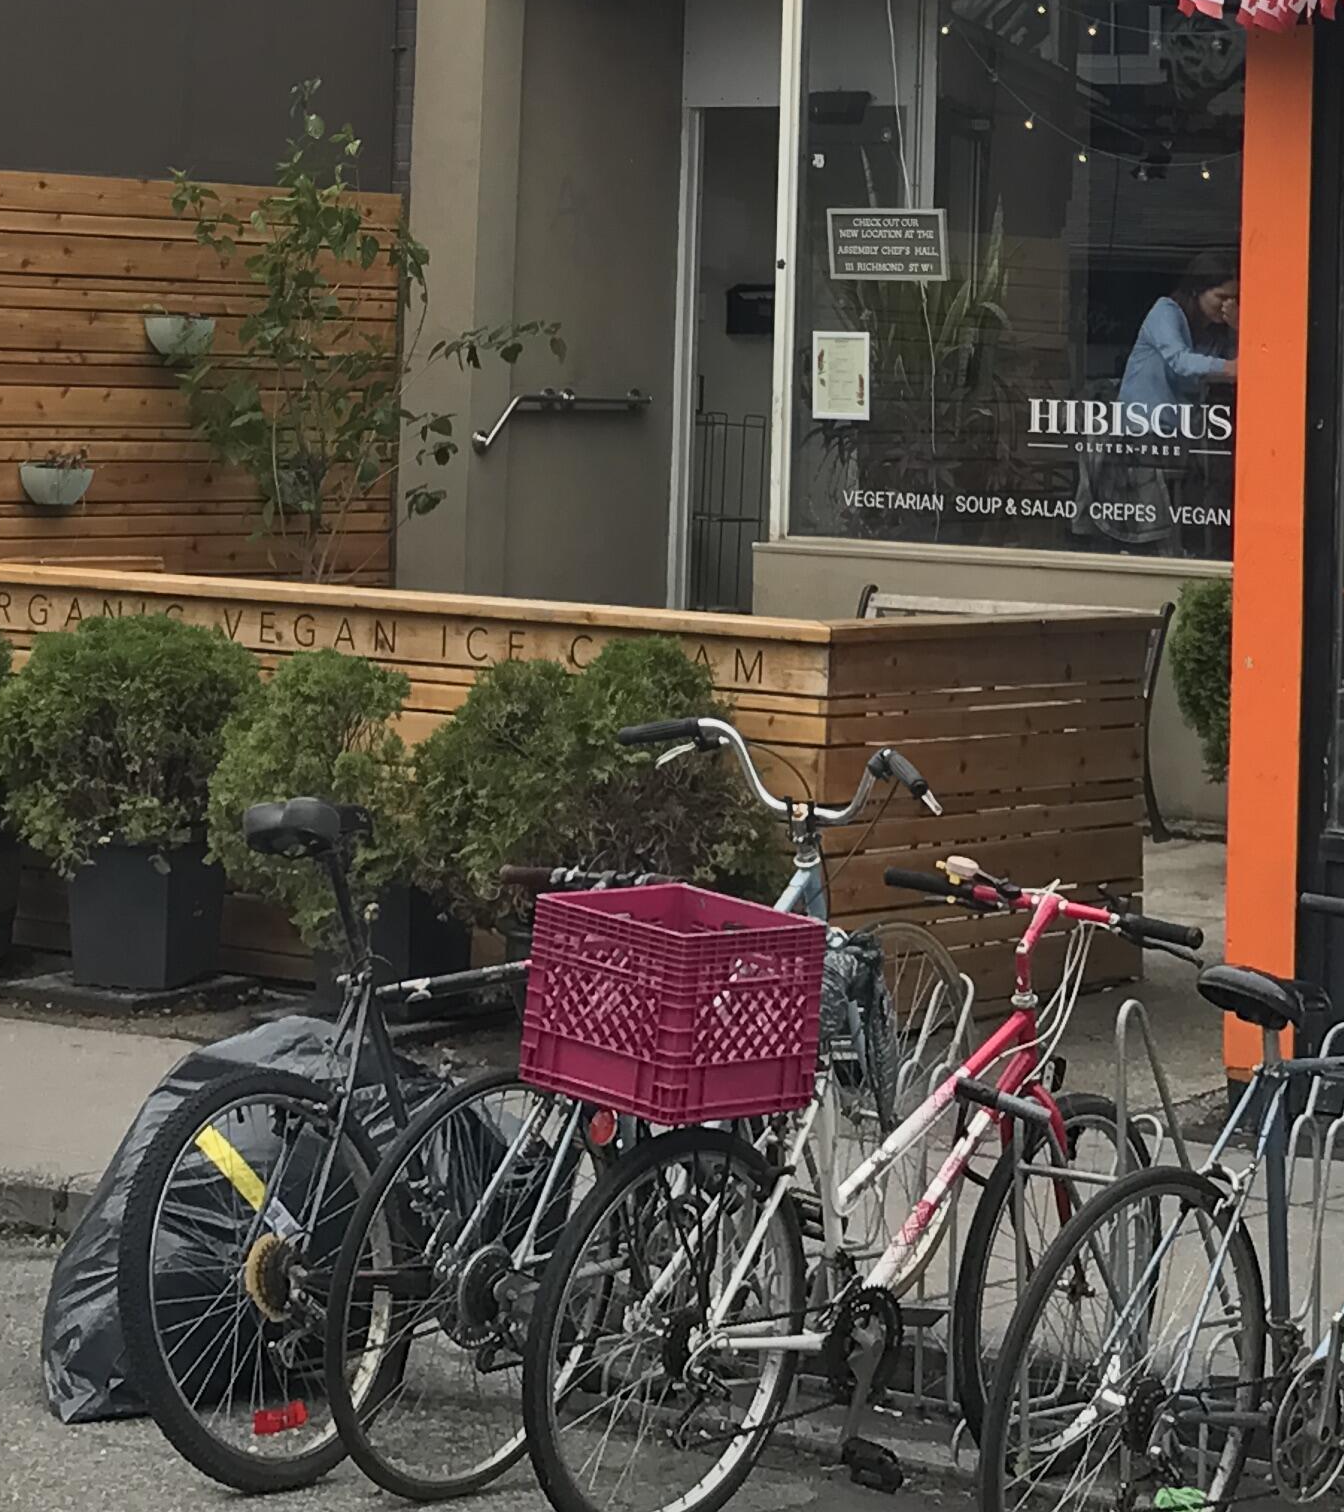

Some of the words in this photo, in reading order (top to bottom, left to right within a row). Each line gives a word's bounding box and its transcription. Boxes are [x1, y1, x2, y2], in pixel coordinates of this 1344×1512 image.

[852, 218, 882, 227] CHECK
[882, 218, 900, 227] OUT
[900, 218, 920, 227] OUR
[839, 230, 858, 238] NEW
[861, 230, 903, 239] LOCATION
[904, 230, 915, 239] AT
[917, 230, 935, 239] THE
[837, 246, 880, 255] ASSEMBLY
[881, 246, 911, 255] CHEF'S
[857, 262, 905, 272] RICHMOND
[908, 263, 920, 272] ST
[1027, 399, 1233, 440] HIBISCUS
[1074, 441, 1182, 457] GLUTEN-FREE
[843, 490, 945, 512] VEGETARIAN
[955, 495, 1003, 515] SOUP
[1004, 497, 1018, 516] &
[1020, 498, 1078, 519] SALAD
[1089, 503, 1157, 523] CREPES
[1169, 506, 1232, 527] VEGAN
[223, 606, 397, 654] VEGAN
[441, 624, 526, 662] ICE
[570, 634, 764, 685] CAM
